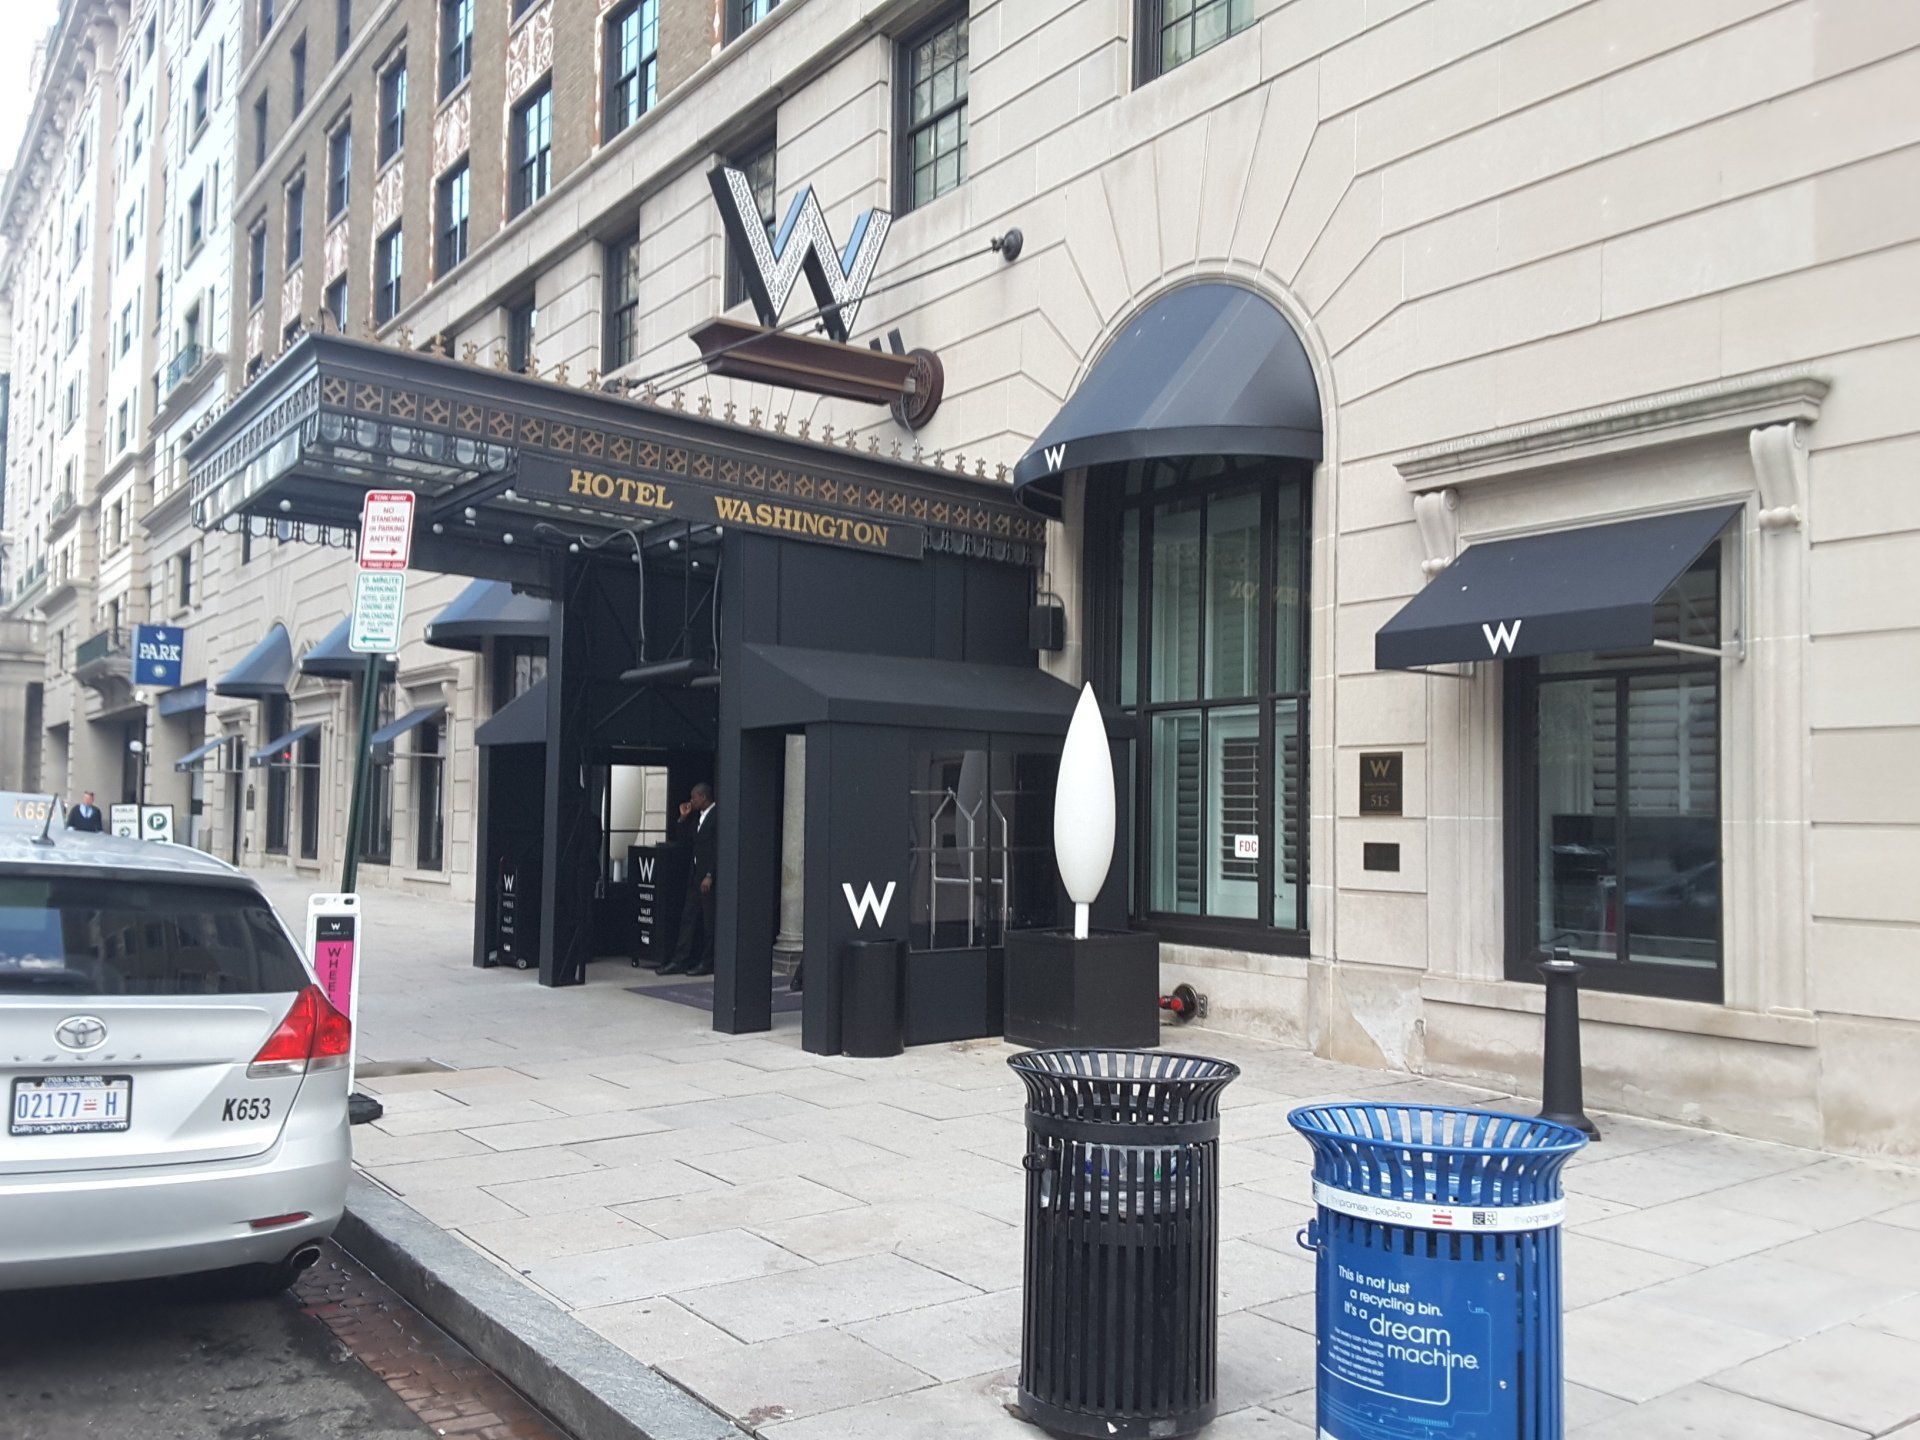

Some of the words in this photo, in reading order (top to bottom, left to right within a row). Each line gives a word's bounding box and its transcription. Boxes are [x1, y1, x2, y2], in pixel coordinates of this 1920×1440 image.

[707, 164, 894, 344] W
[1044, 443, 1066, 472] W
[569, 468, 674, 510] HOTEL
[714, 496, 890, 546] WASHINGTON
[1482, 619, 1522, 655] W
[139, 643, 181, 661] PARK
[1370, 759, 1391, 778] W
[1239, 840, 1257, 853] FDC
[503, 874, 515, 892] W
[639, 856, 655, 882] W
[842, 881, 897, 929] W
[331, 922, 341, 931] W
[18, 1092, 81, 1119] 02177
[106, 1091, 118, 1116] H
[221, 1097, 271, 1121] K653
[1338, 1264, 1355, 1281] This
[1356, 1271, 1364, 1285] is
[1366, 1276, 1386, 1290] not
[1387, 1279, 1411, 1294] just
[1349, 1288, 1358, 1299] a
[1359, 1291, 1415, 1315] recycling
[1418, 1301, 1444, 1317] bin.
[1344, 1300, 1358, 1317] It's
[1359, 1308, 1368, 1320] a
[1369, 1312, 1451, 1347] dream
[1387, 1344, 1480, 1370] machine.
